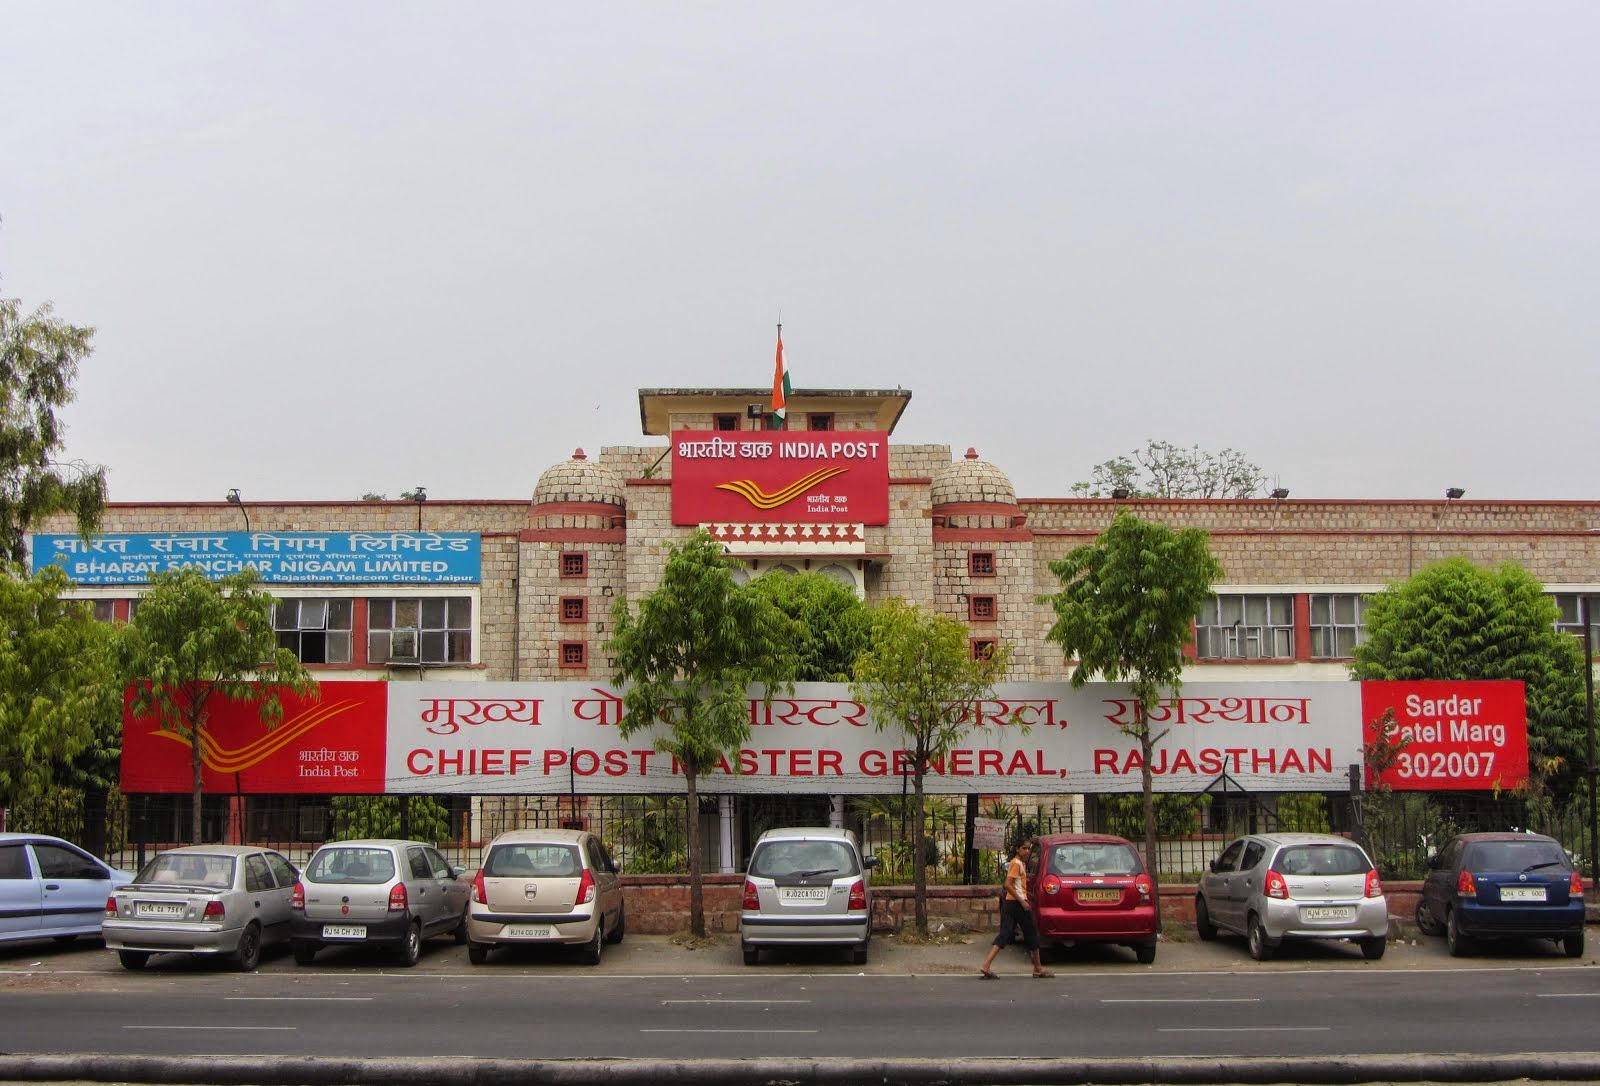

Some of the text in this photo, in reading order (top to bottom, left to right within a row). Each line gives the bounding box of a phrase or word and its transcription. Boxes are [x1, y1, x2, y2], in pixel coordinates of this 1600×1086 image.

[679, 437, 773, 458] भारतीय डाक
[779, 442, 880, 459] INDIA POST
[806, 493, 848, 503] भारतीय डाक
[807, 505, 849, 513] India Post
[52, 533, 472, 553] भारत संचार निगम लिमिटेड
[75, 560, 449, 574] BHARAT SANCHAR NIGAM LIMITED
[273, 573, 333, 583] Rajasthan
[392, 574, 432, 582] Circle,
[435, 574, 474, 583] Jaipur
[1405, 694, 1482, 717] Sardar
[420, 699, 545, 735] मुख्य
[1102, 697, 1312, 725] राजस्थान
[1385, 719, 1505, 746] Patel Marg
[299, 747, 359, 762] भारतीय डाक
[406, 749, 532, 775] CHIEF
[543, 749, 656, 776] POST
[858, 749, 1067, 778] GENERAL,
[1094, 748, 1333, 775] RAJASTHAN
[299, 765, 359, 777] India Post
[1397, 751, 1495, 778] 302007
